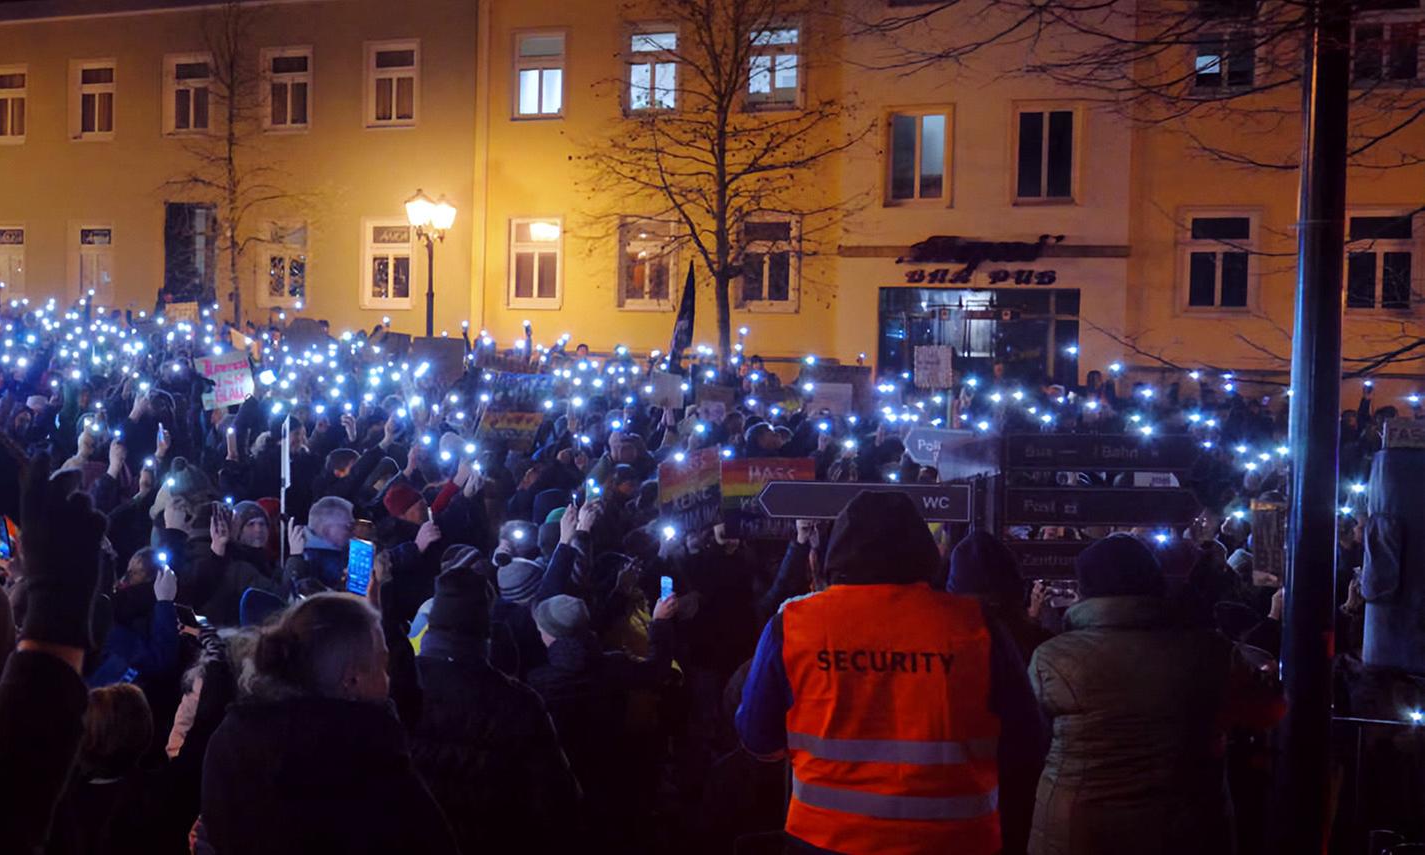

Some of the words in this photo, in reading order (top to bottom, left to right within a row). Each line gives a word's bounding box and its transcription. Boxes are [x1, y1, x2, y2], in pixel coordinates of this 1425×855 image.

[988, 270, 1057, 285] PUB
[918, 439, 942, 452] Poli
[922, 496, 950, 509] WC
[816, 649, 955, 675] SECURITY
